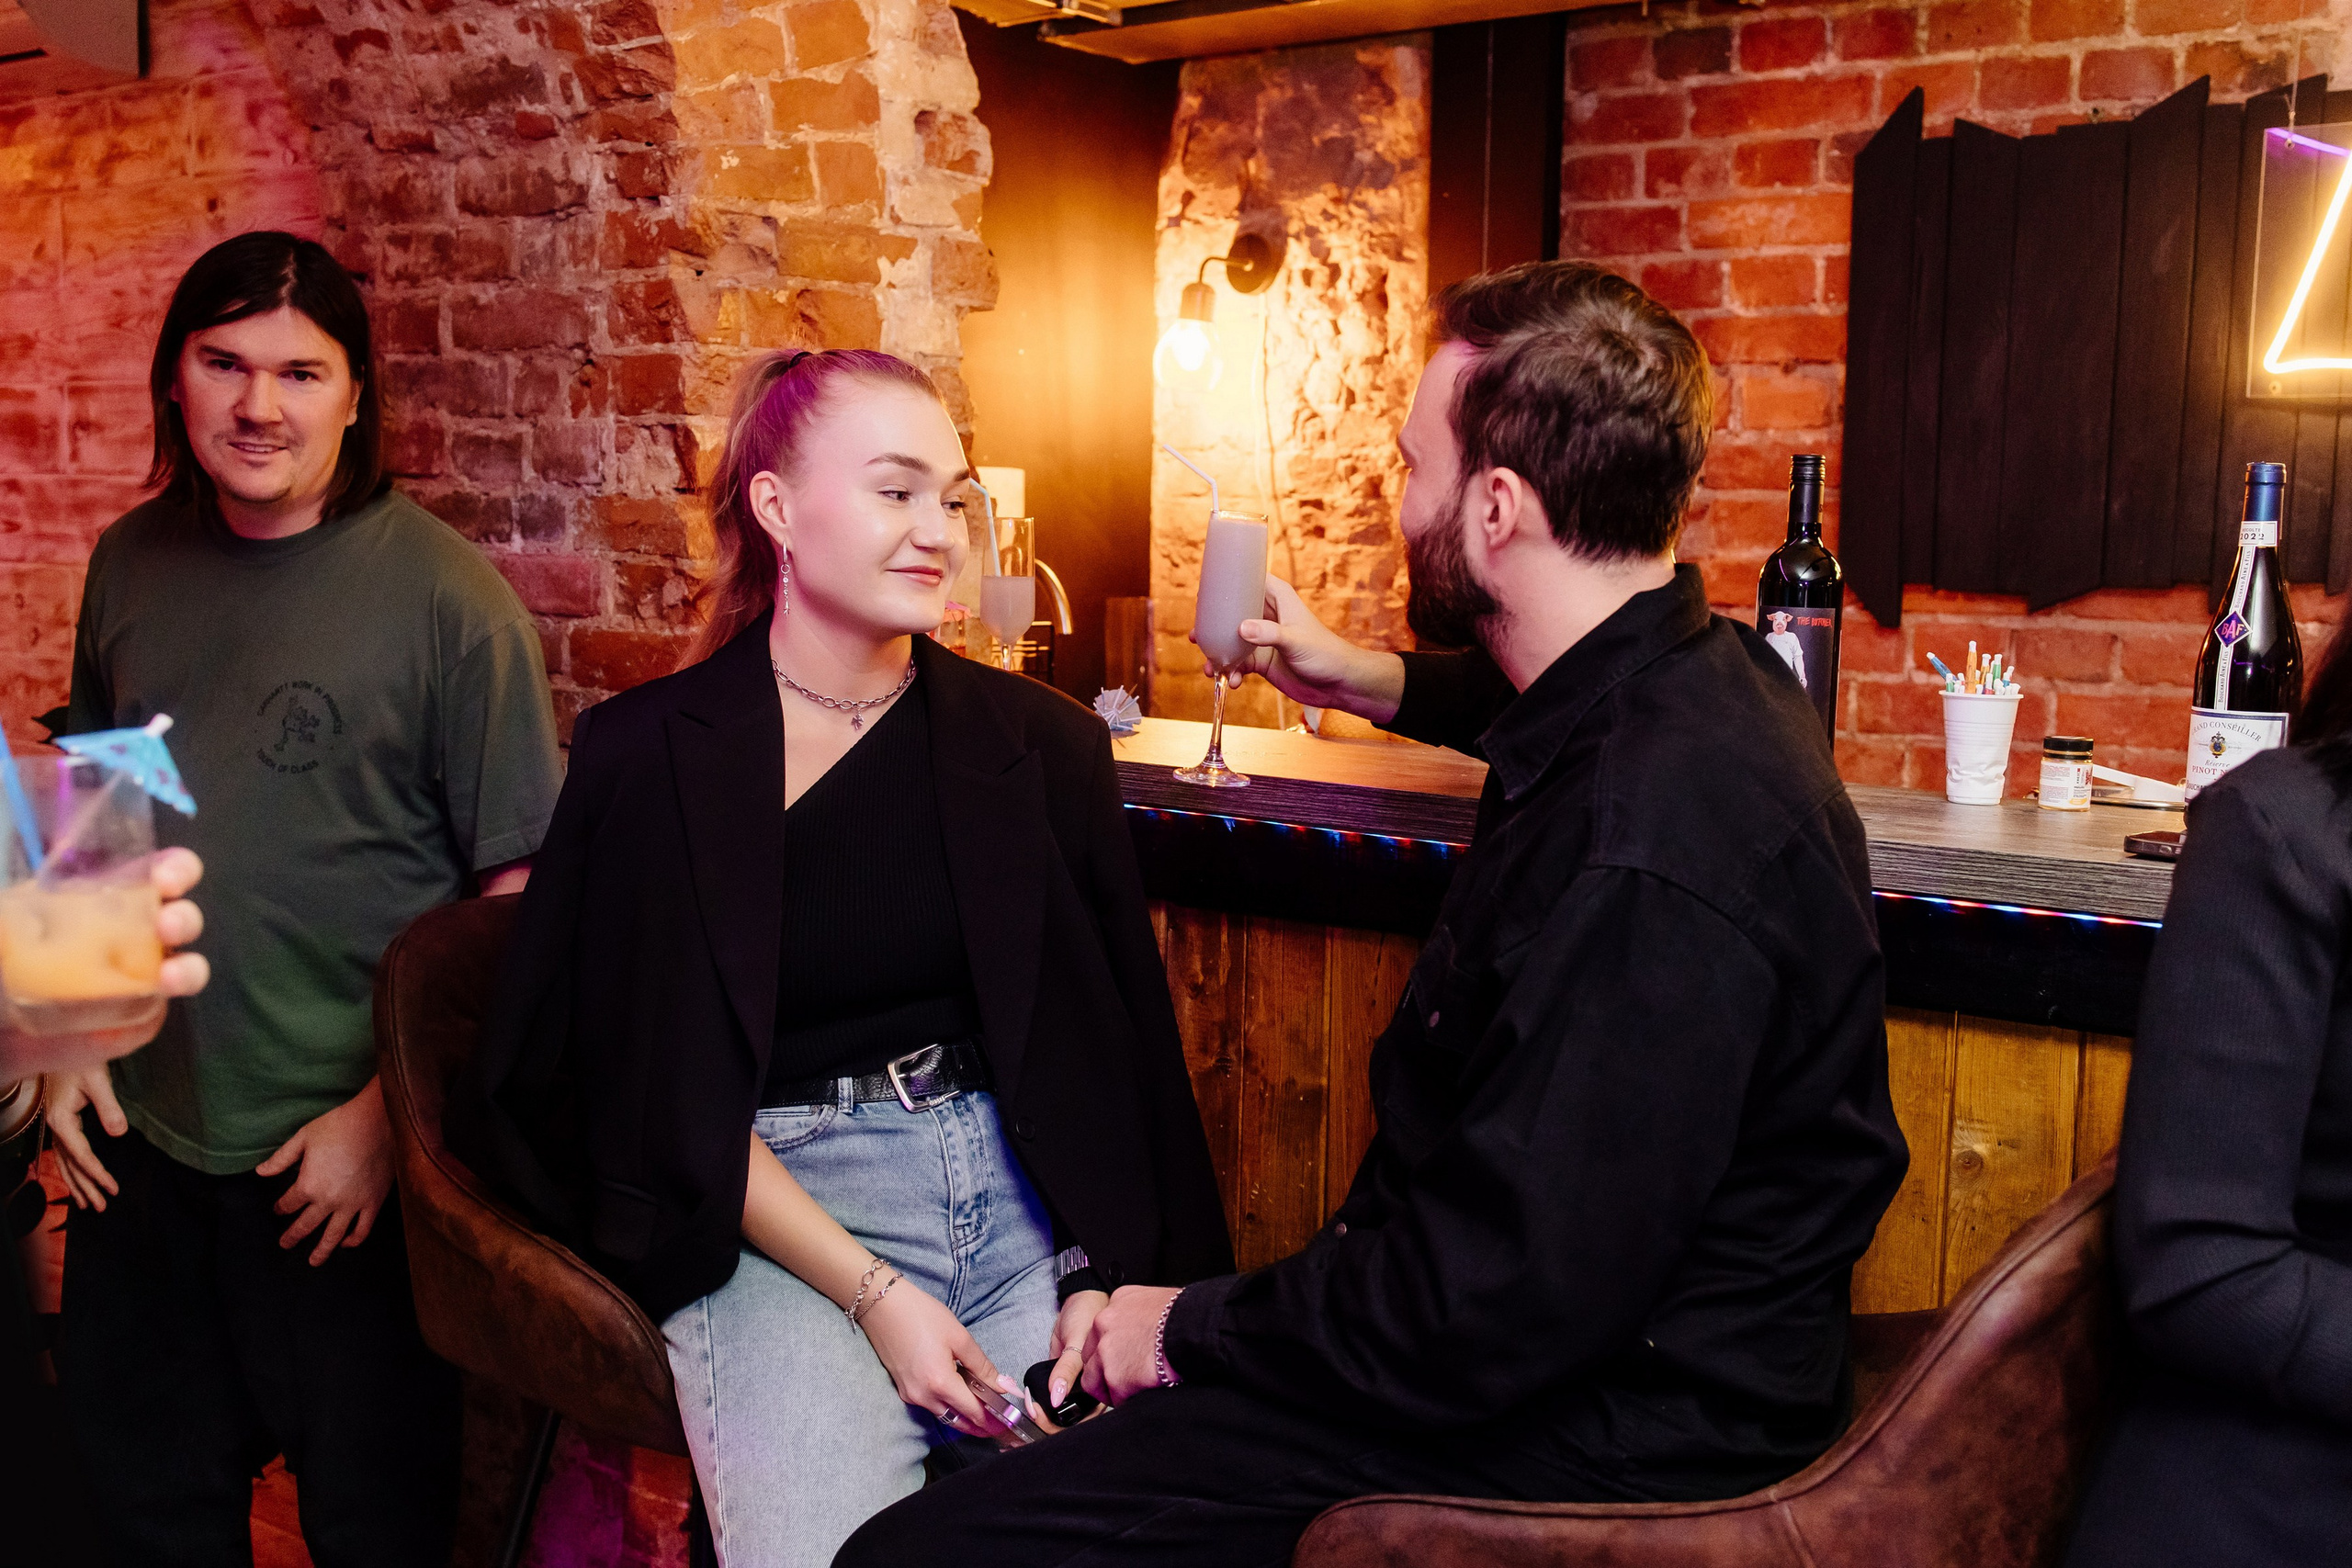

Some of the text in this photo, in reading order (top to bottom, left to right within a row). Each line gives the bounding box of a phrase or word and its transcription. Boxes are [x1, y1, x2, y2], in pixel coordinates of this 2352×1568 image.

[1797, 616, 1811, 626] THE
[277, 764, 288, 773] OF
[290, 760, 319, 773] CLASS
[2192, 765, 2217, 775] PINOT
